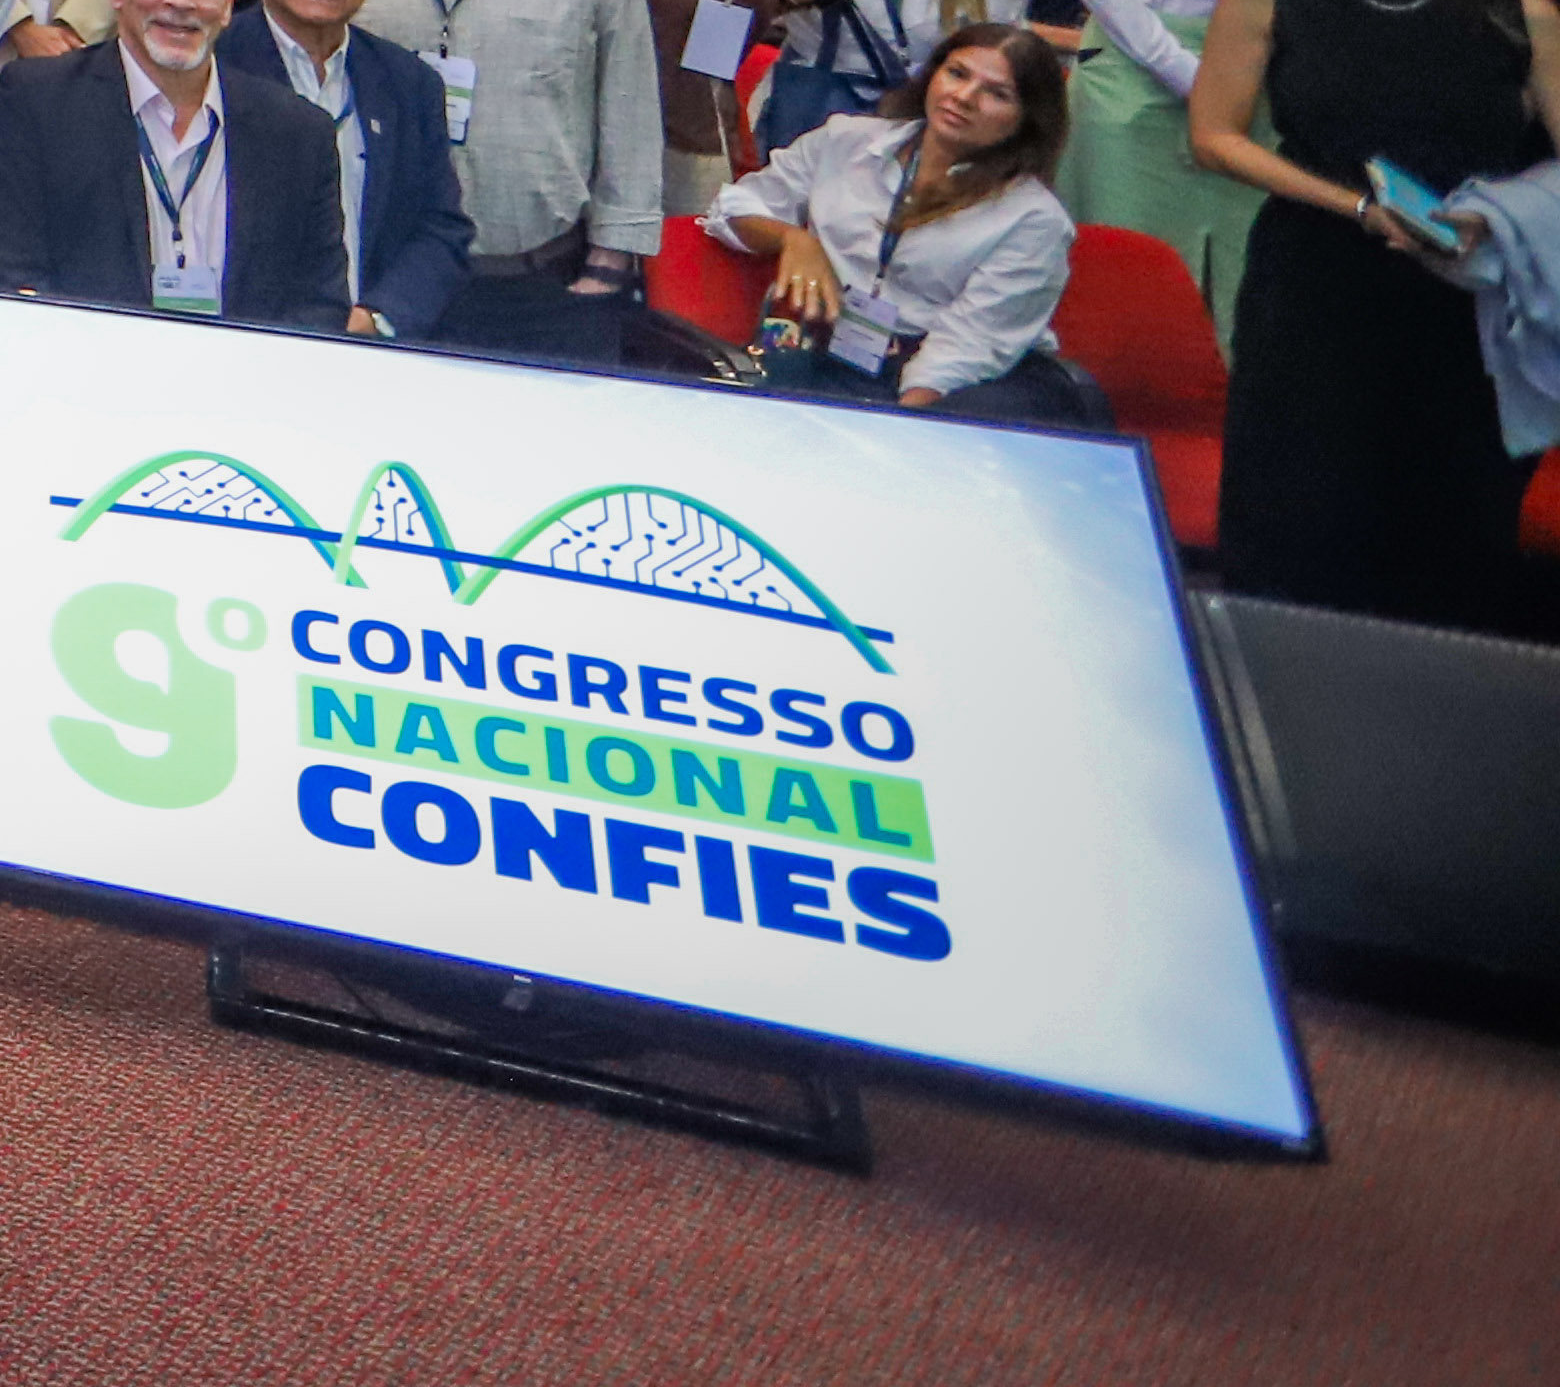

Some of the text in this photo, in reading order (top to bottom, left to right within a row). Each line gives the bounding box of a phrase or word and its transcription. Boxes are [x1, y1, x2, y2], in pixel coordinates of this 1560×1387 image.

[291, 609, 916, 762] CONGRESSO
[310, 685, 918, 848] NACIONAL
[296, 764, 953, 963] CONFIES
